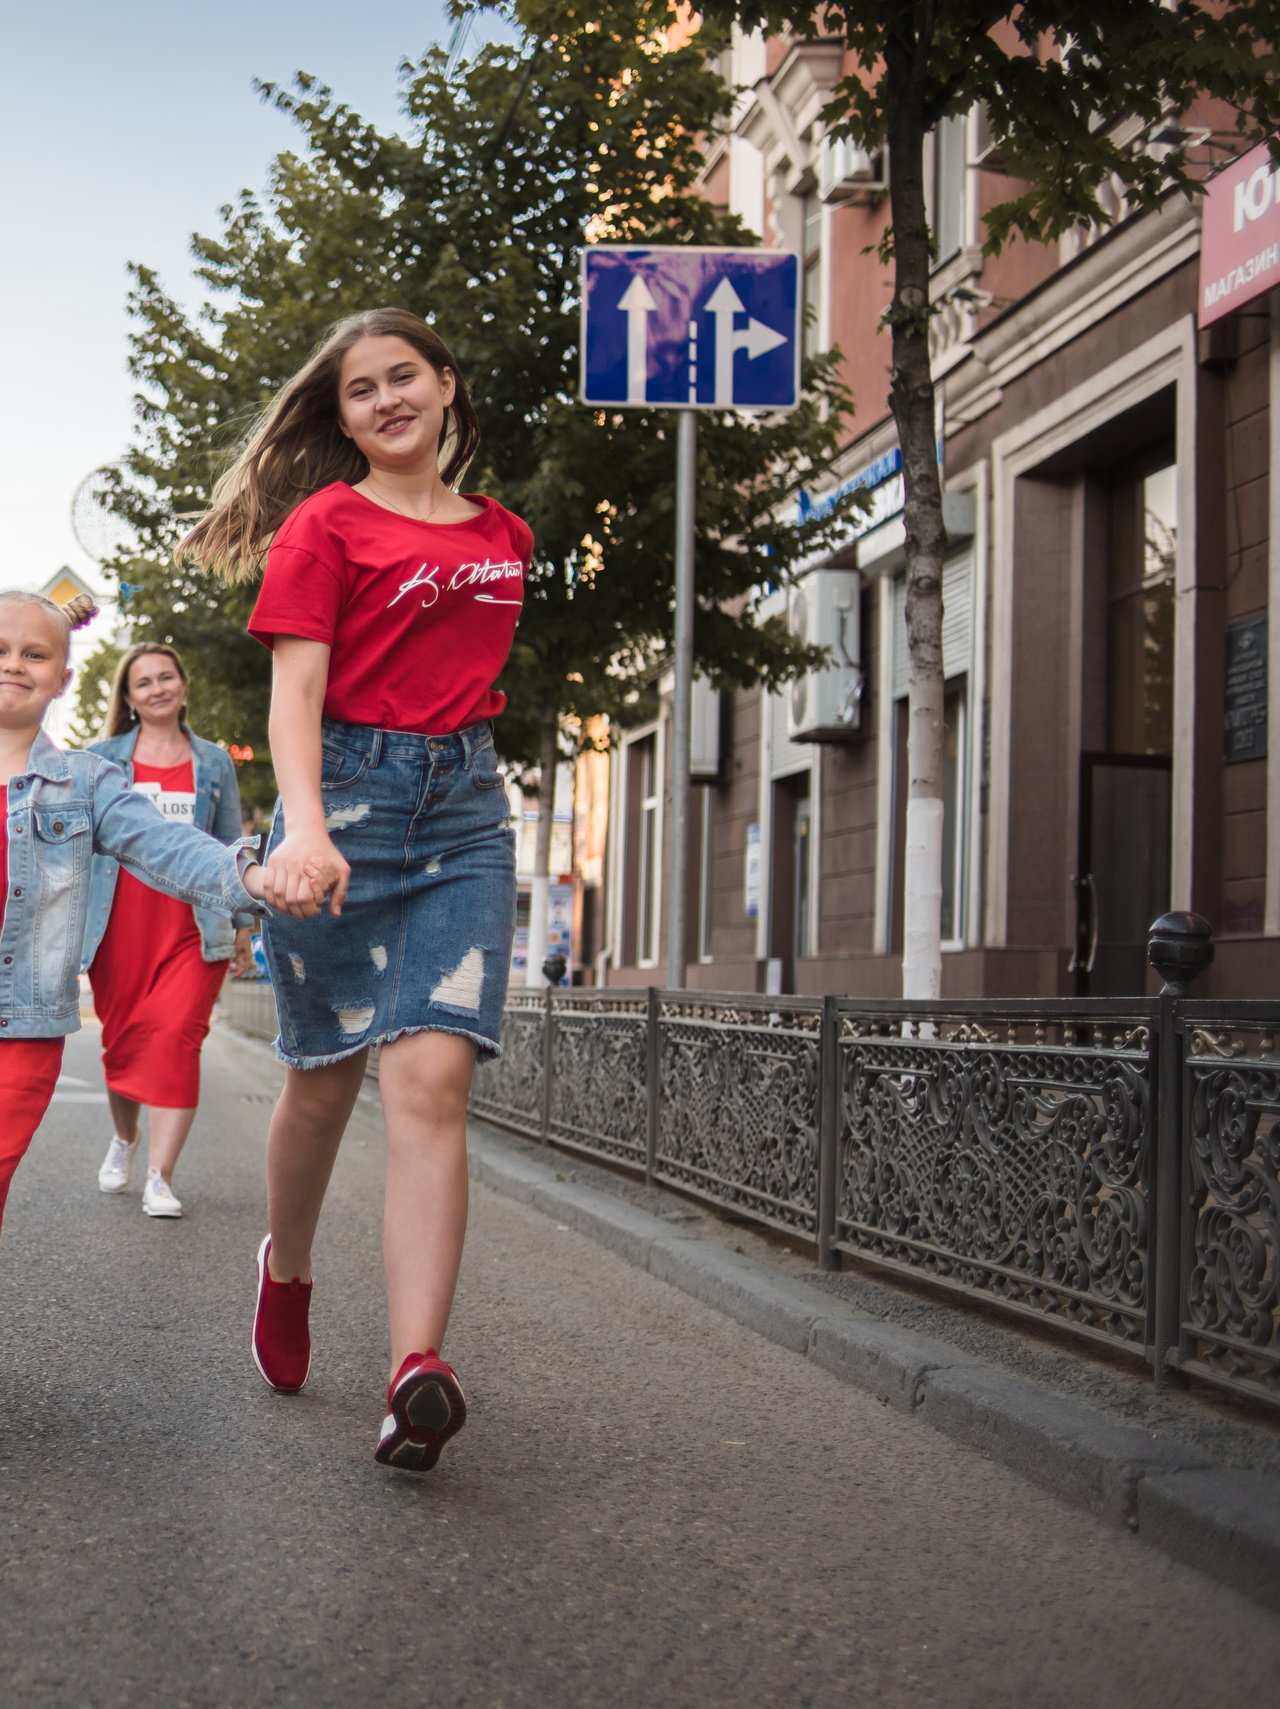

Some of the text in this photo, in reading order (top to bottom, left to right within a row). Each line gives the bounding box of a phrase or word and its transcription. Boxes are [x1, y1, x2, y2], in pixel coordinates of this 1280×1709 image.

[1233, 165, 1280, 234] Ю
[1204, 242, 1280, 309] МАГАЗИН
[163, 803, 196, 816] LOST
